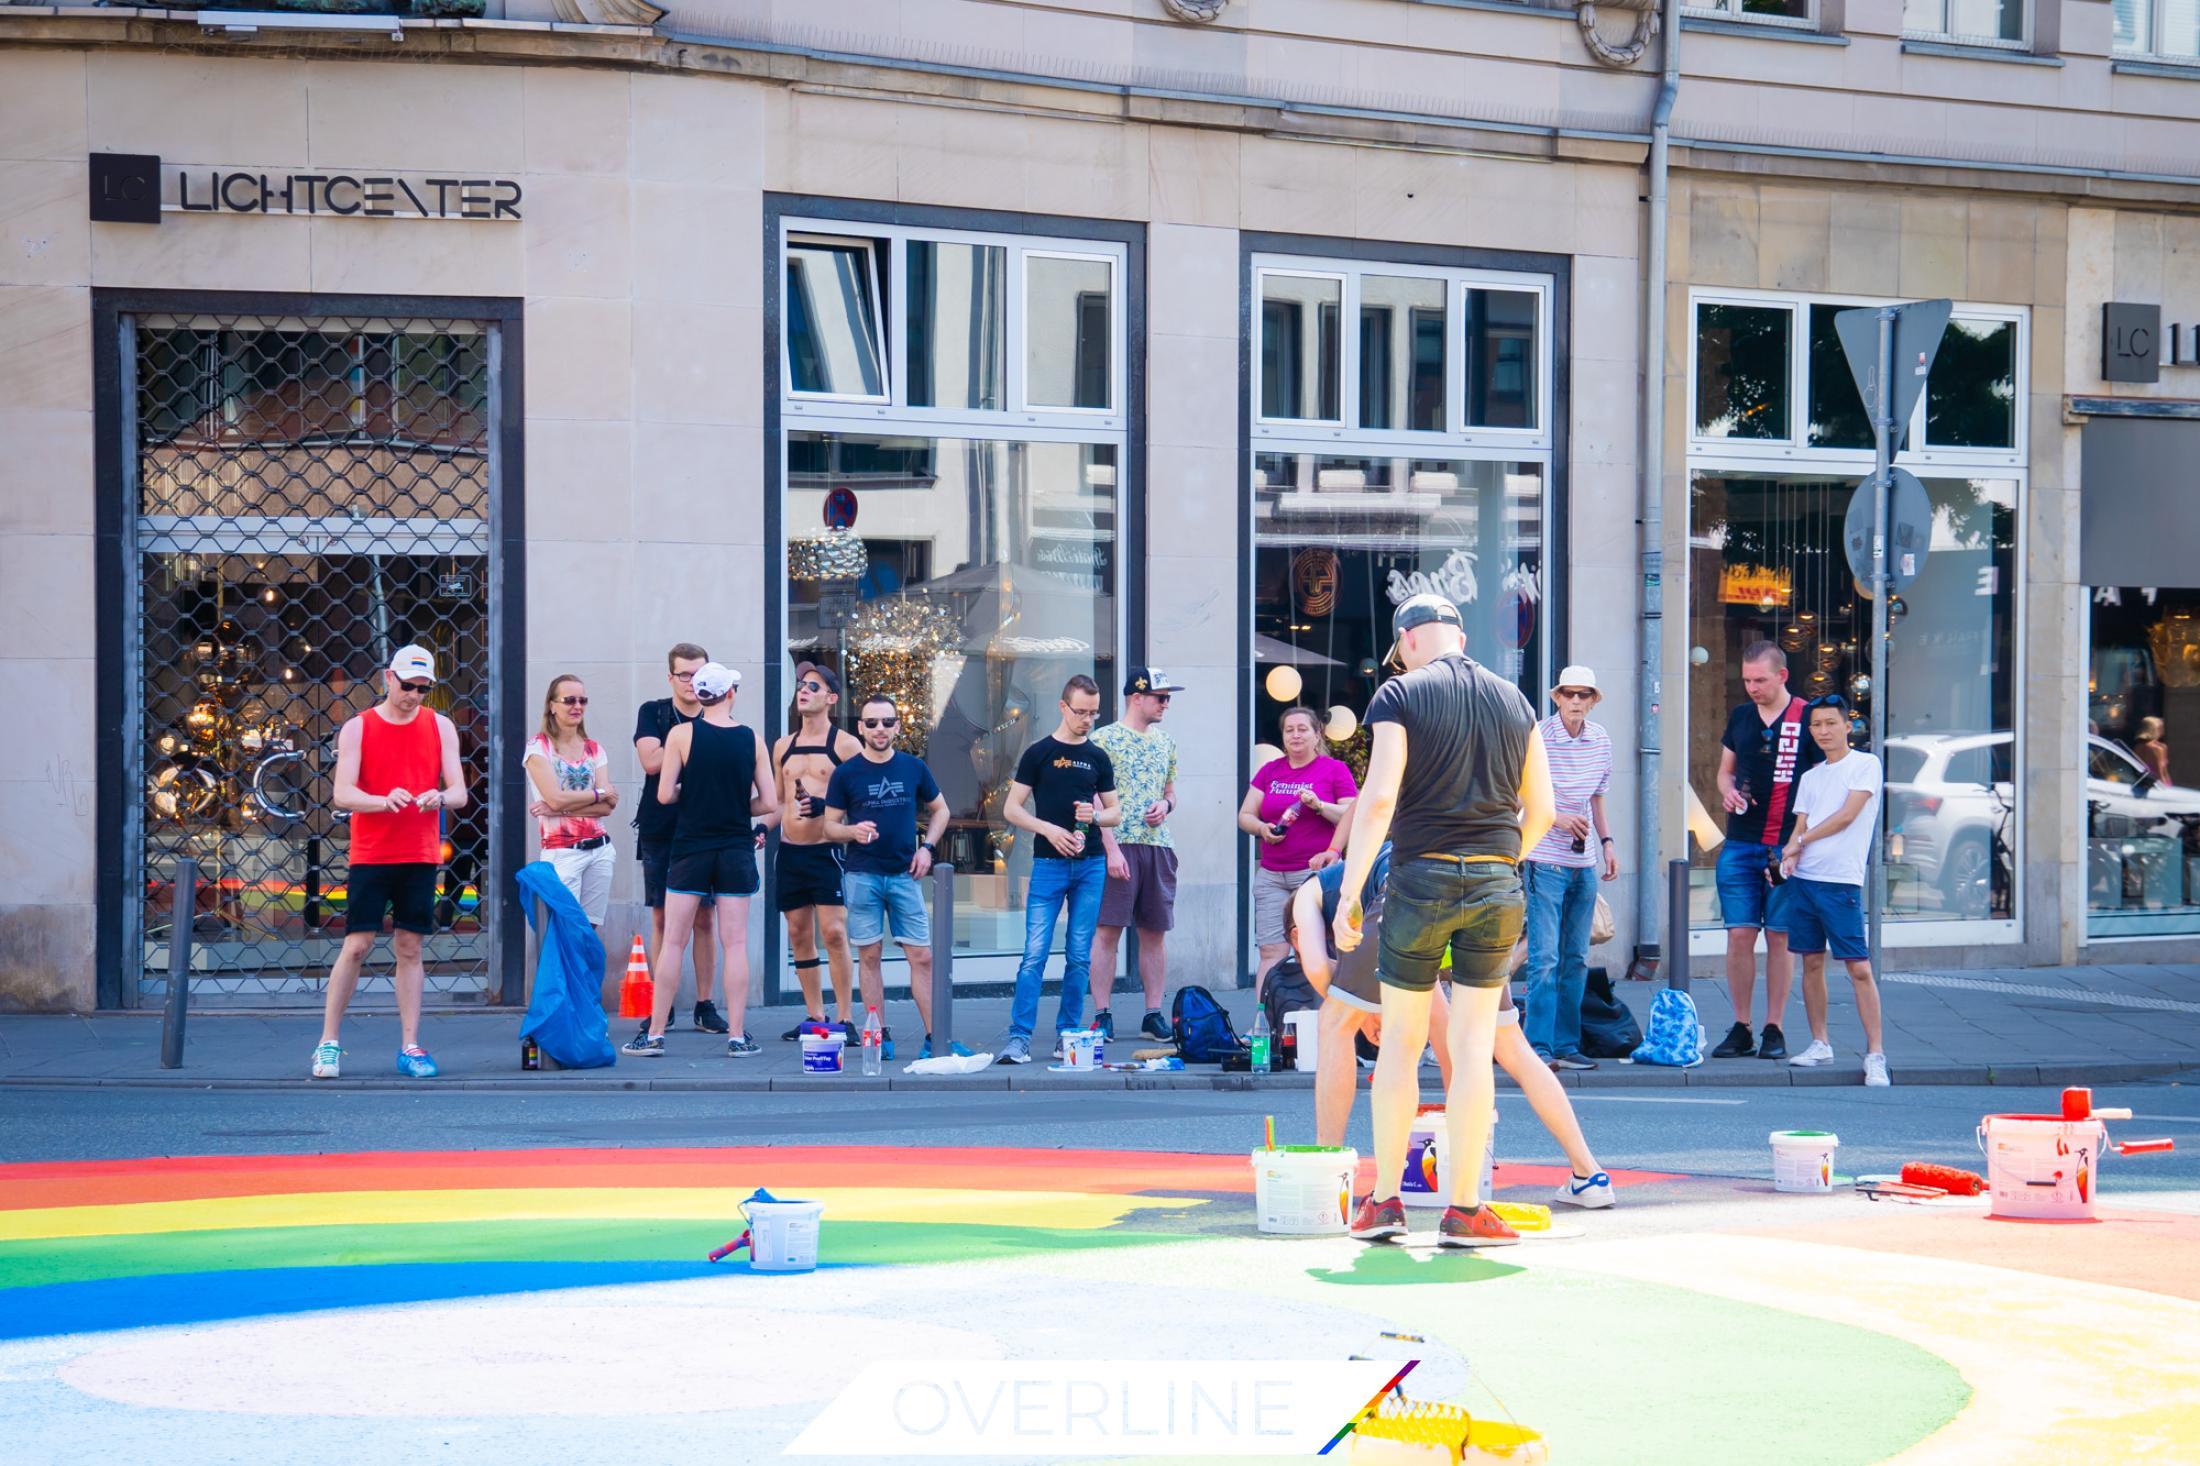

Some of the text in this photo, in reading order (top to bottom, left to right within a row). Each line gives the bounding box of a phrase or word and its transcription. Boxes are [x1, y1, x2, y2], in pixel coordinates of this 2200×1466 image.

[180, 171, 522, 219] LICHTCENTER
[2117, 327, 2150, 358] LC
[1270, 780, 1313, 791] Feminist
